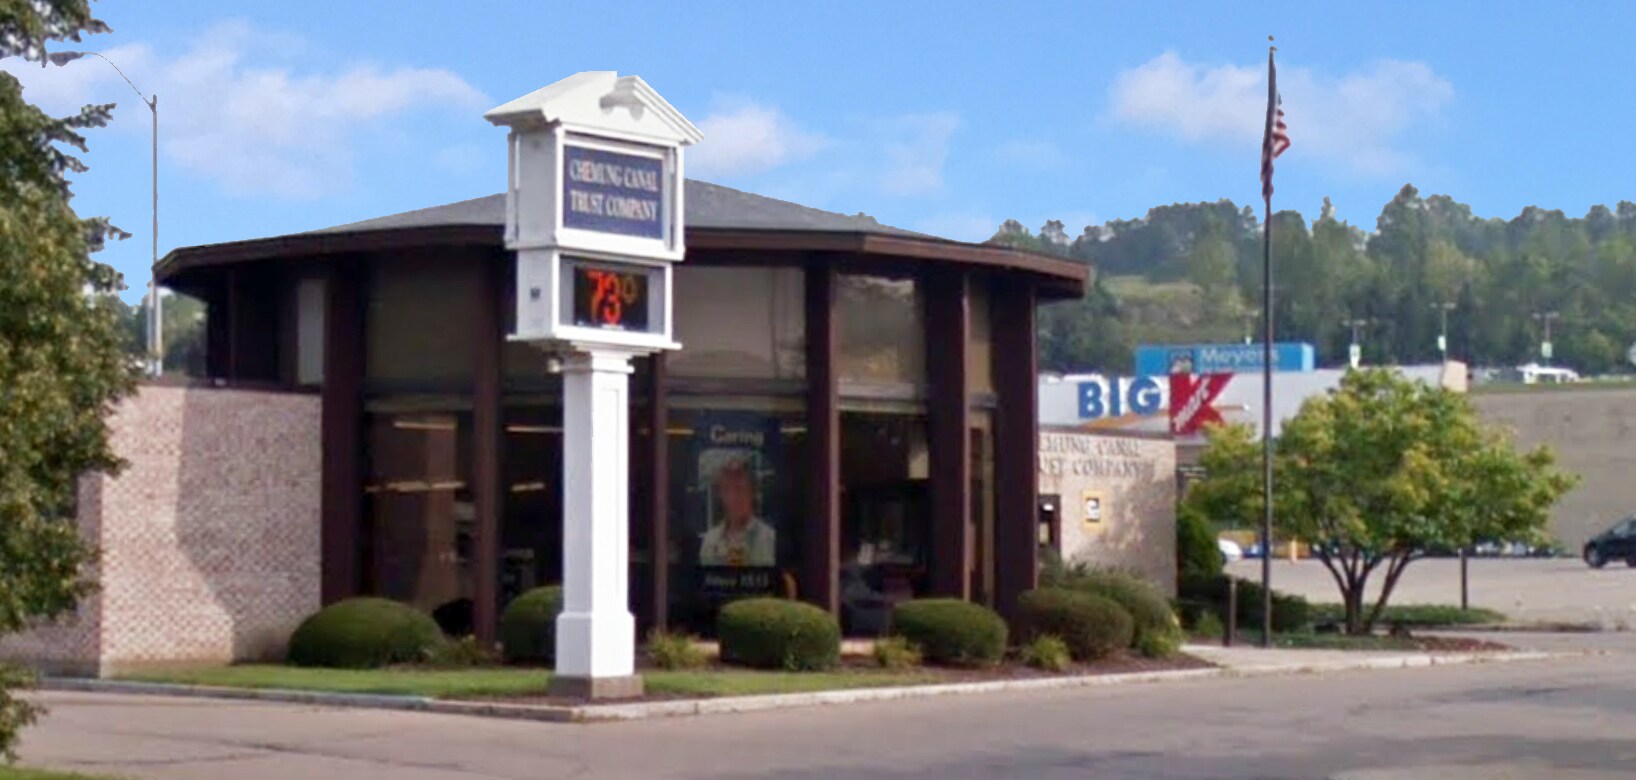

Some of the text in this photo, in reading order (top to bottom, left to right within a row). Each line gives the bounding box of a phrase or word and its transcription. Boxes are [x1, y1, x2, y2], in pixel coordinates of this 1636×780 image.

[569, 158, 659, 192] CHEMUNG CANAL
[569, 189, 658, 221] TRUST COMPANY
[1078, 374, 1162, 419] BIG
[710, 424, 764, 447] Caring
[1096, 438, 1141, 458] CANAL
[1072, 458, 1143, 479] COMPANY
